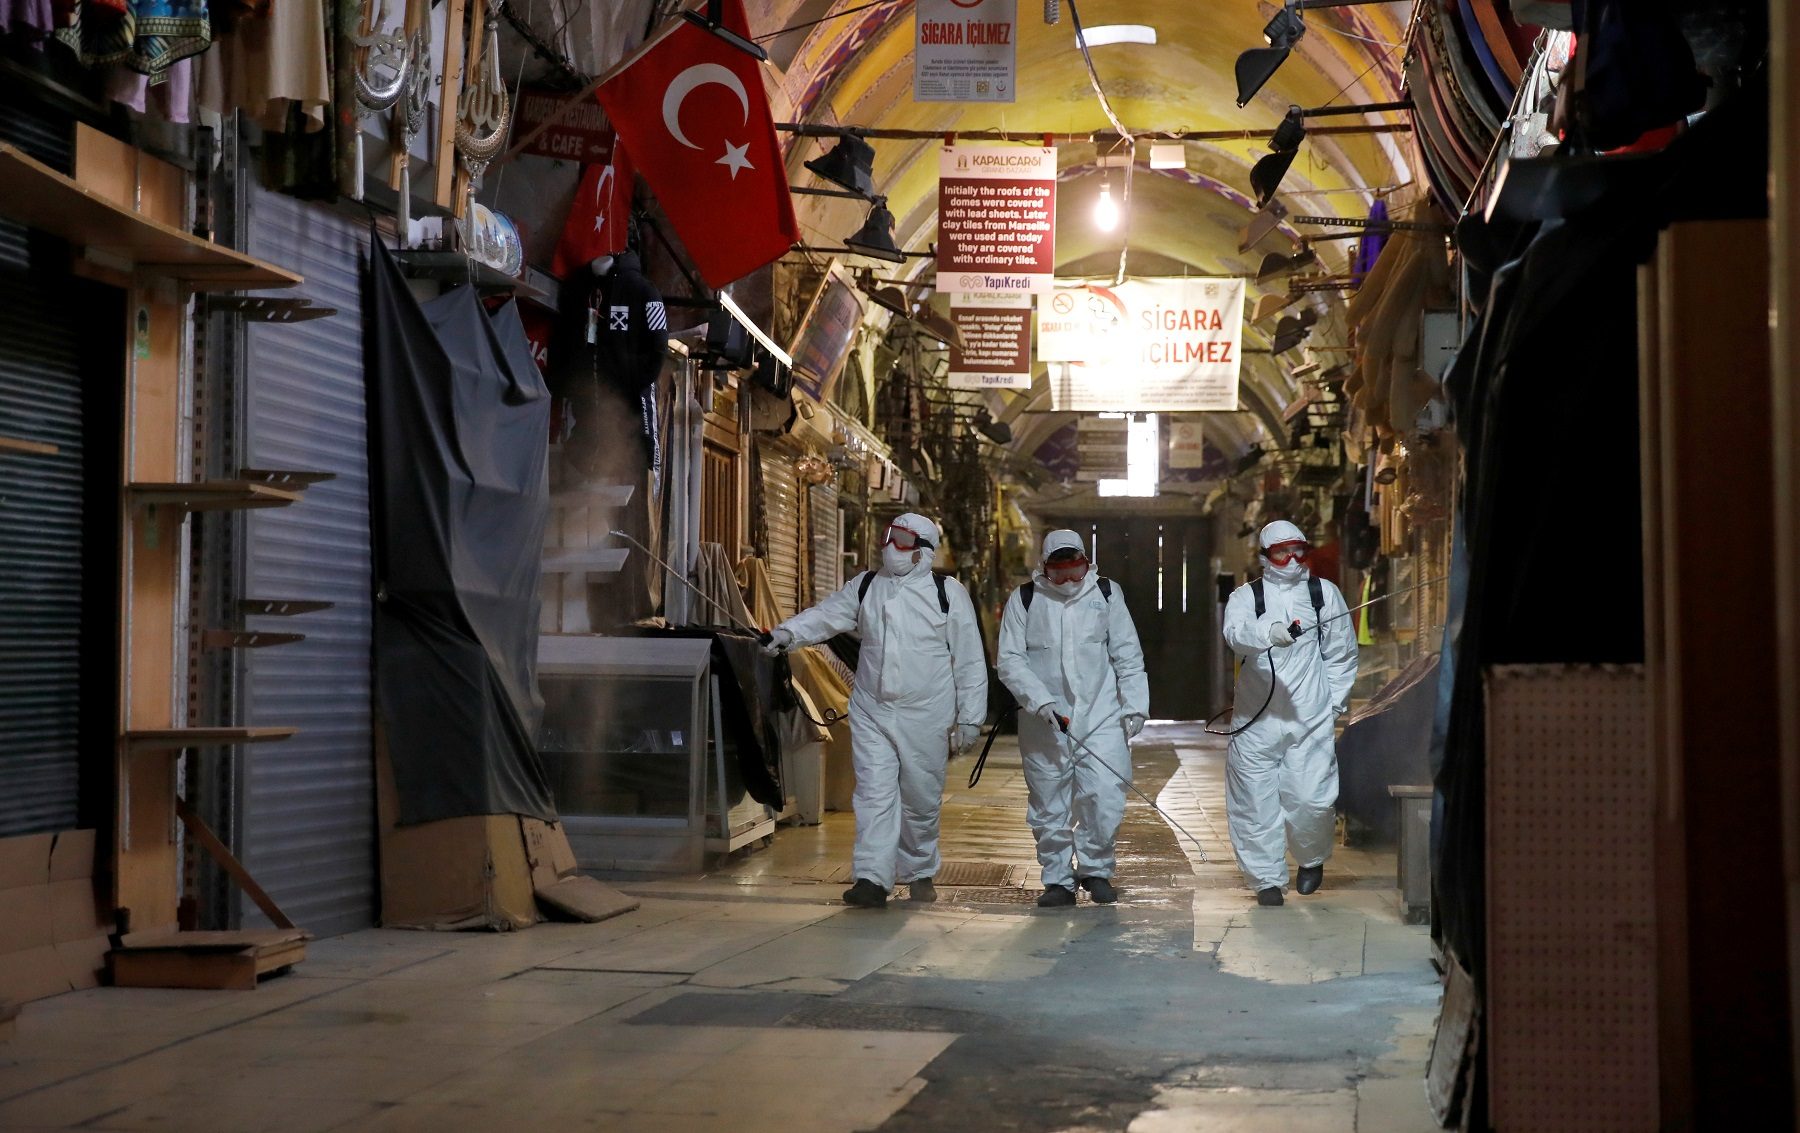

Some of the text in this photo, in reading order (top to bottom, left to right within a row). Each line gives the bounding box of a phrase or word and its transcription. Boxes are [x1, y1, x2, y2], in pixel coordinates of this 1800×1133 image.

[921, 19, 1011, 48] SİGARA İÇİLMEZ
[551, 133, 584, 156] CAFE
[944, 186, 1051, 197] Initially the roofs of the
[950, 197, 1044, 208] domes were covered
[945, 208, 1048, 219] with lead sheets. Later
[942, 220, 1051, 231] clay tiles from Marseille
[974, 232, 996, 241] used
[997, 232, 1015, 241] and
[1016, 232, 1043, 244] today
[957, 243, 978, 253] they
[997, 244, 1033, 253] covered
[952, 254, 1038, 266] with ordinary tiles.
[984, 275, 1031, 290] YapıKredi
[1141, 304, 1223, 331] SİGARA
